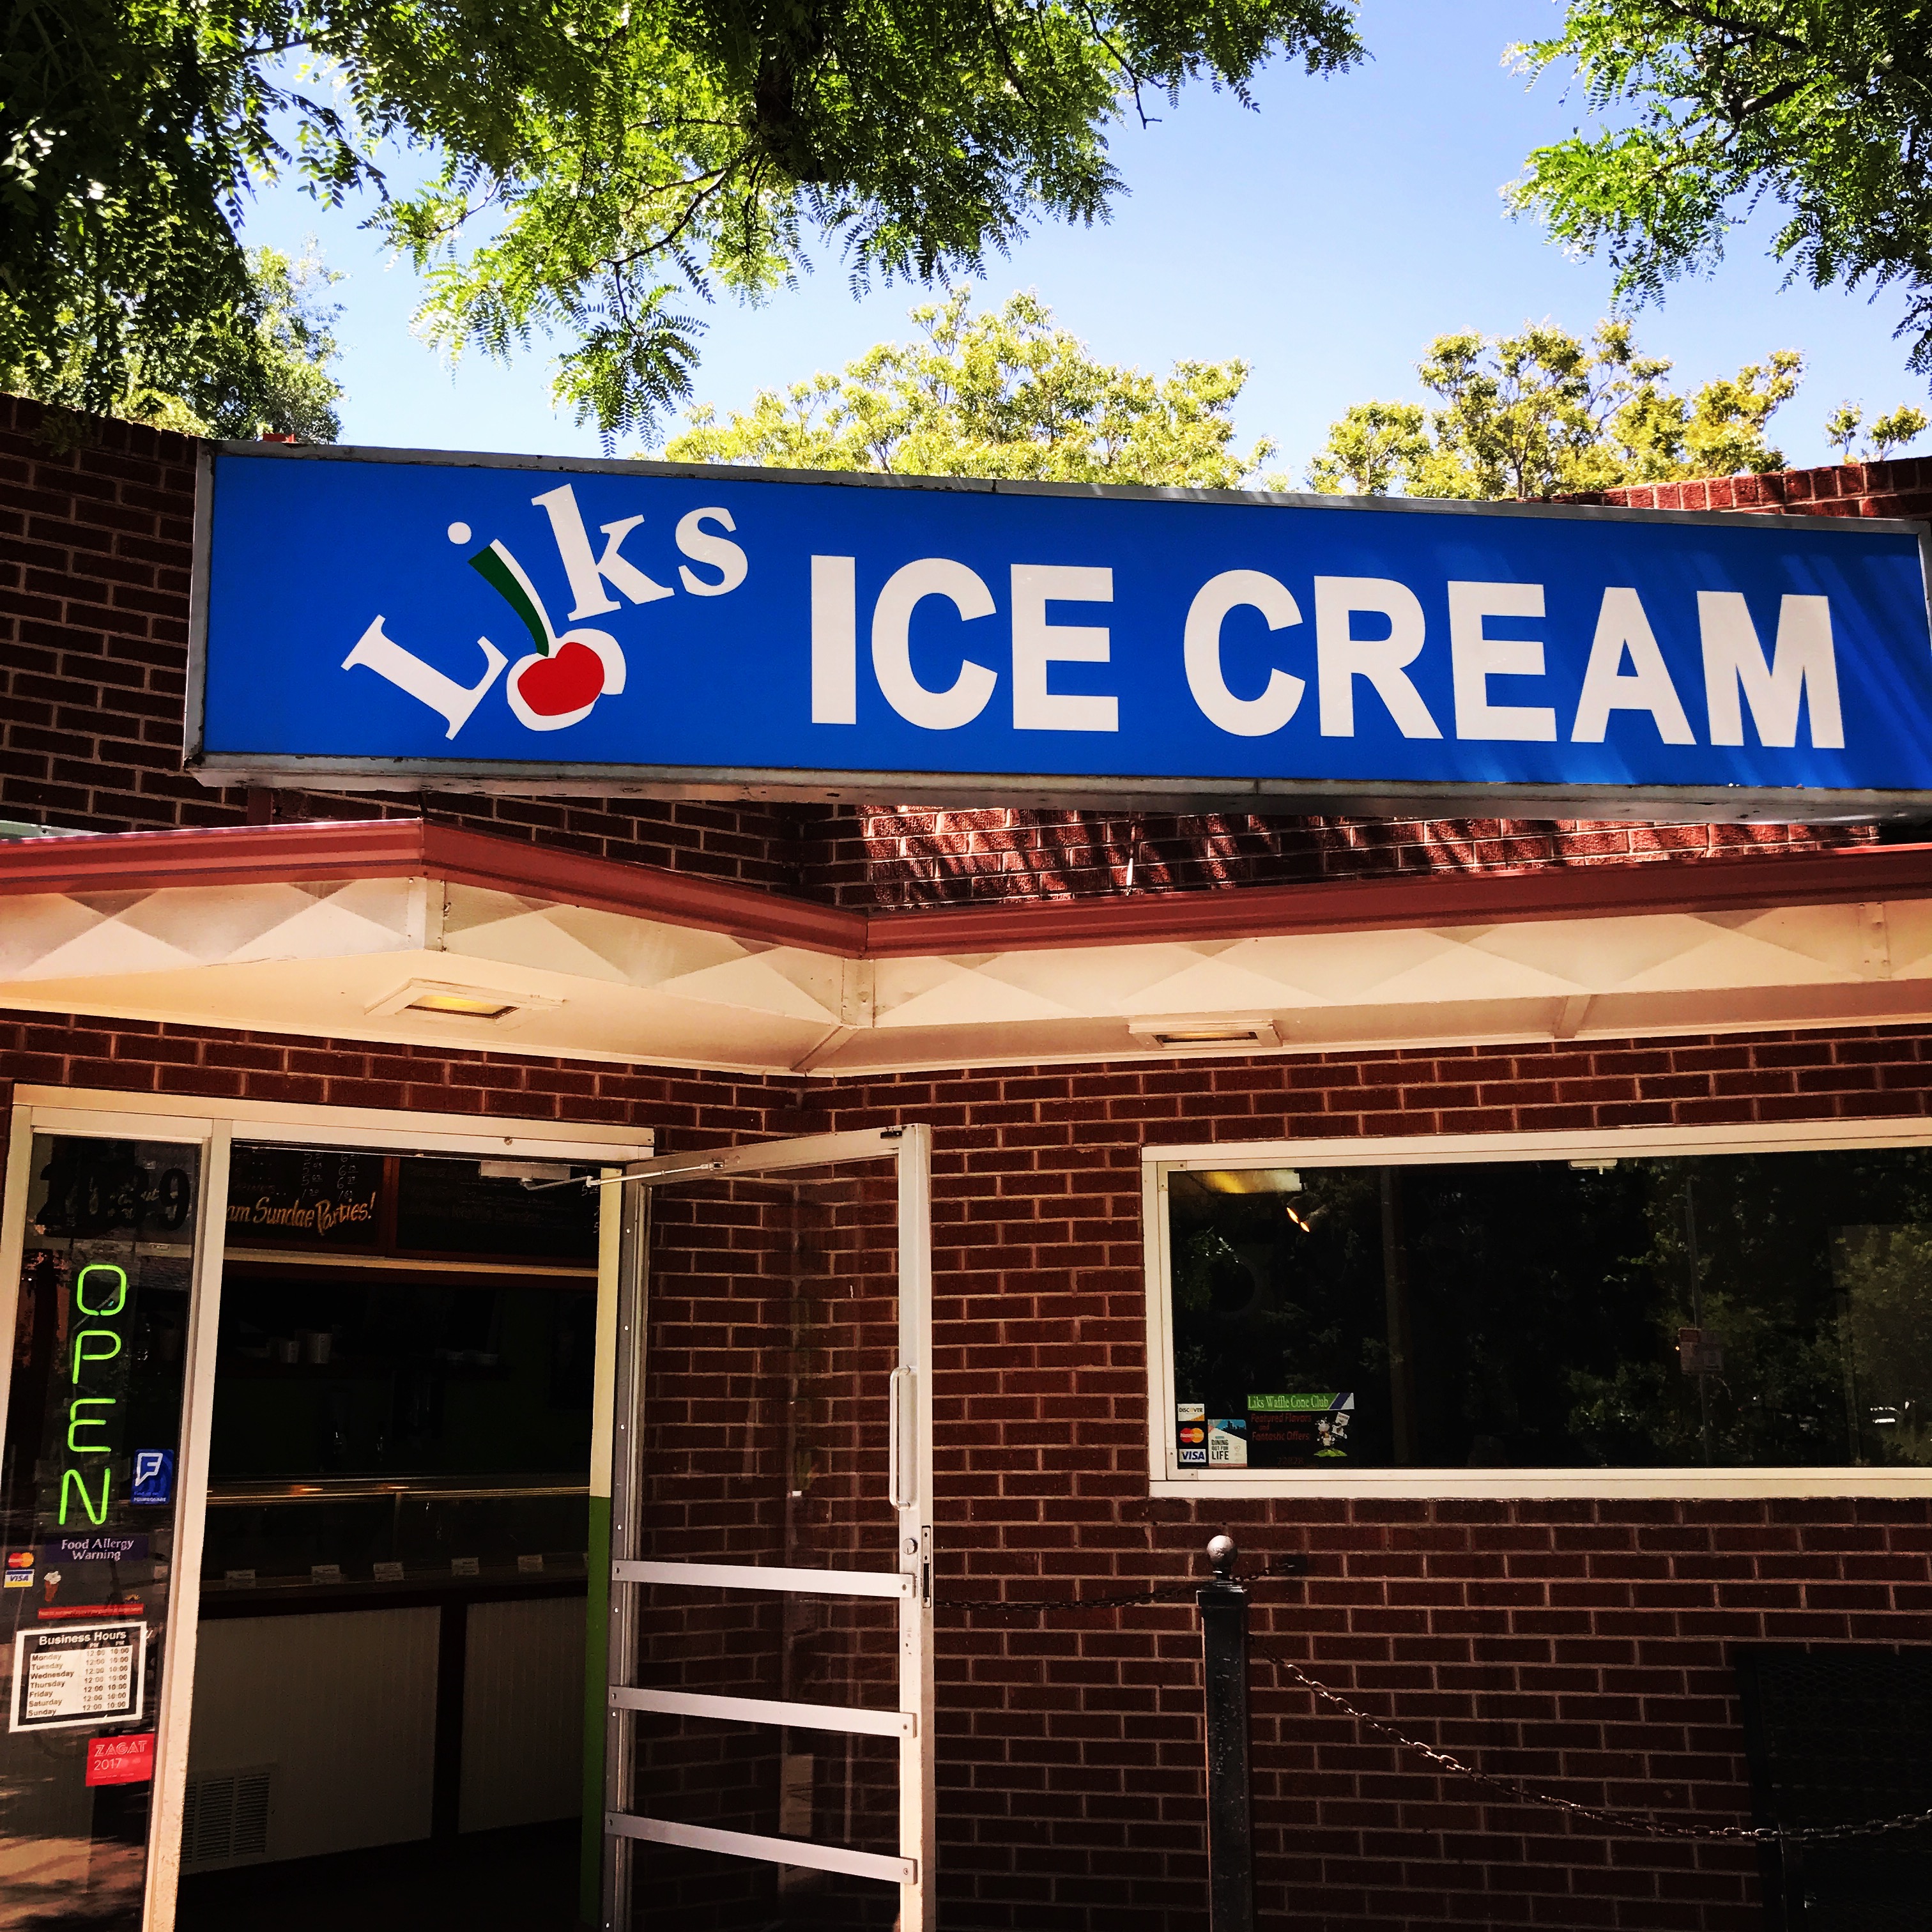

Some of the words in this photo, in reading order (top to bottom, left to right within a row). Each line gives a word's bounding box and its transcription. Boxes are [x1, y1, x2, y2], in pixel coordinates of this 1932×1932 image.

[341, 483, 749, 741] Liks
[811, 555, 1119, 732] ICE
[1183, 569, 1845, 749] CREAM
[253, 1196, 316, 1228] Sundae
[315, 1192, 376, 1236] Parties!
[58, 1264, 127, 1525] OPEN
[1248, 1395, 1264, 1408] Liks
[1266, 1395, 1289, 1408] Waffle
[1291, 1395, 1309, 1408] Cone
[1311, 1395, 1329, 1407] Club
[1181, 1451, 1205, 1460] VISA
[1211, 1451, 1229, 1460] LIFE
[61, 1539, 89, 1550] Food
[91, 1538, 134, 1551] Allergy
[72, 1550, 121, 1561] Warning
[39, 1634, 91, 1646] Business
[94, 1631, 126, 1641] Hours
[32, 1662, 63, 1671] Tuesday
[31, 1670, 75, 1680] Wednesday
[30, 1680, 66, 1689] Thursday
[29, 1699, 62, 1707] Saturday
[95, 1740, 147, 1757] ZAGAT
[94, 1758, 122, 1770] 2017
